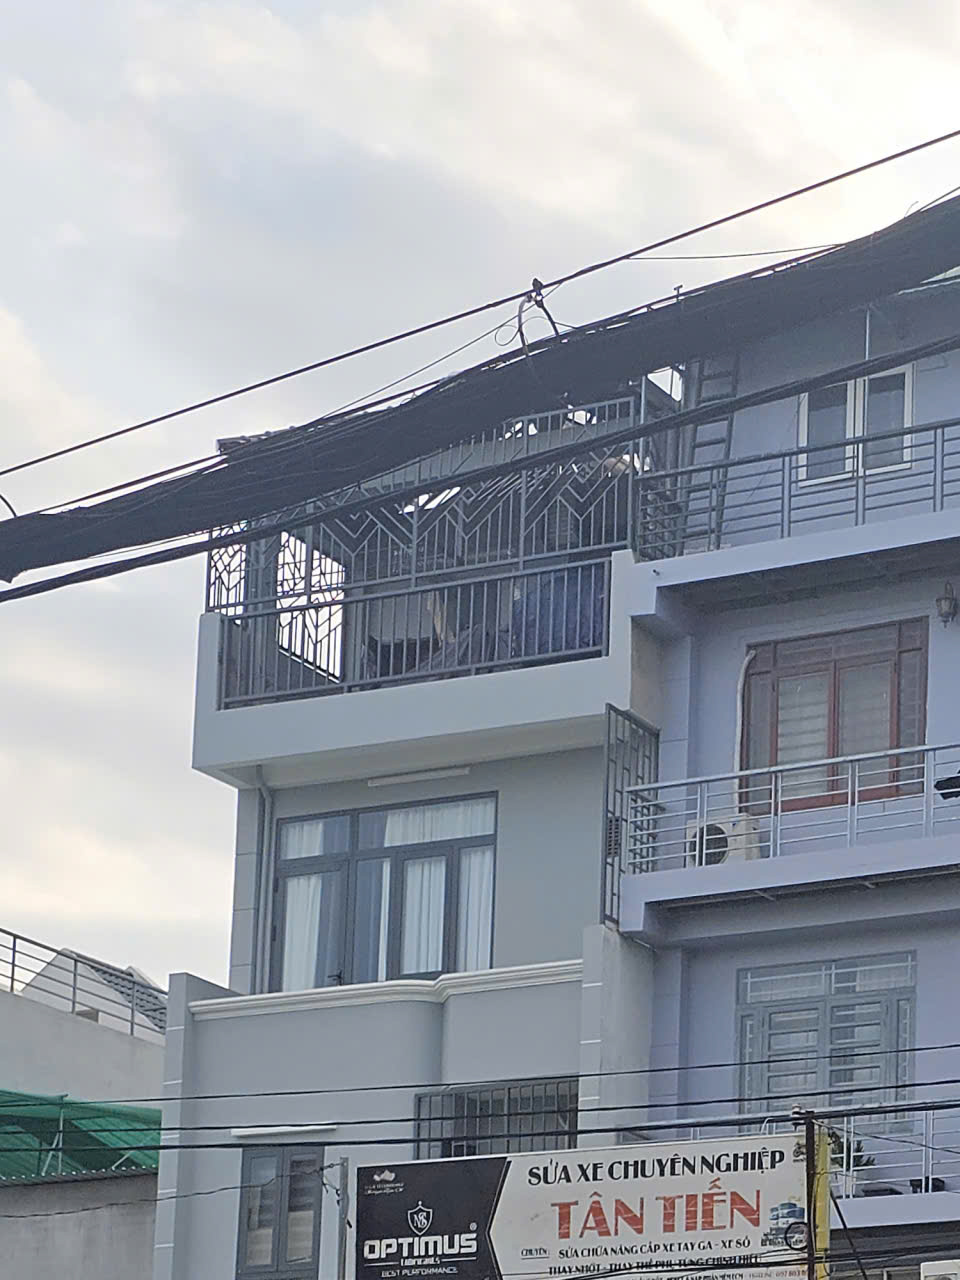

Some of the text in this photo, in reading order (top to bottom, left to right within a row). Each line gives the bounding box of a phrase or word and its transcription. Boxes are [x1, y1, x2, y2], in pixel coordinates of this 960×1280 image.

[528, 1147, 785, 1186] SỬA XE CHUYÊN NGHIỆP
[551, 1177, 760, 1239] TÂN TIẾN
[363, 1233, 478, 1259] OPTIMUS
[677, 1242, 695, 1251] TAY
[698, 1240, 712, 1250] GA
